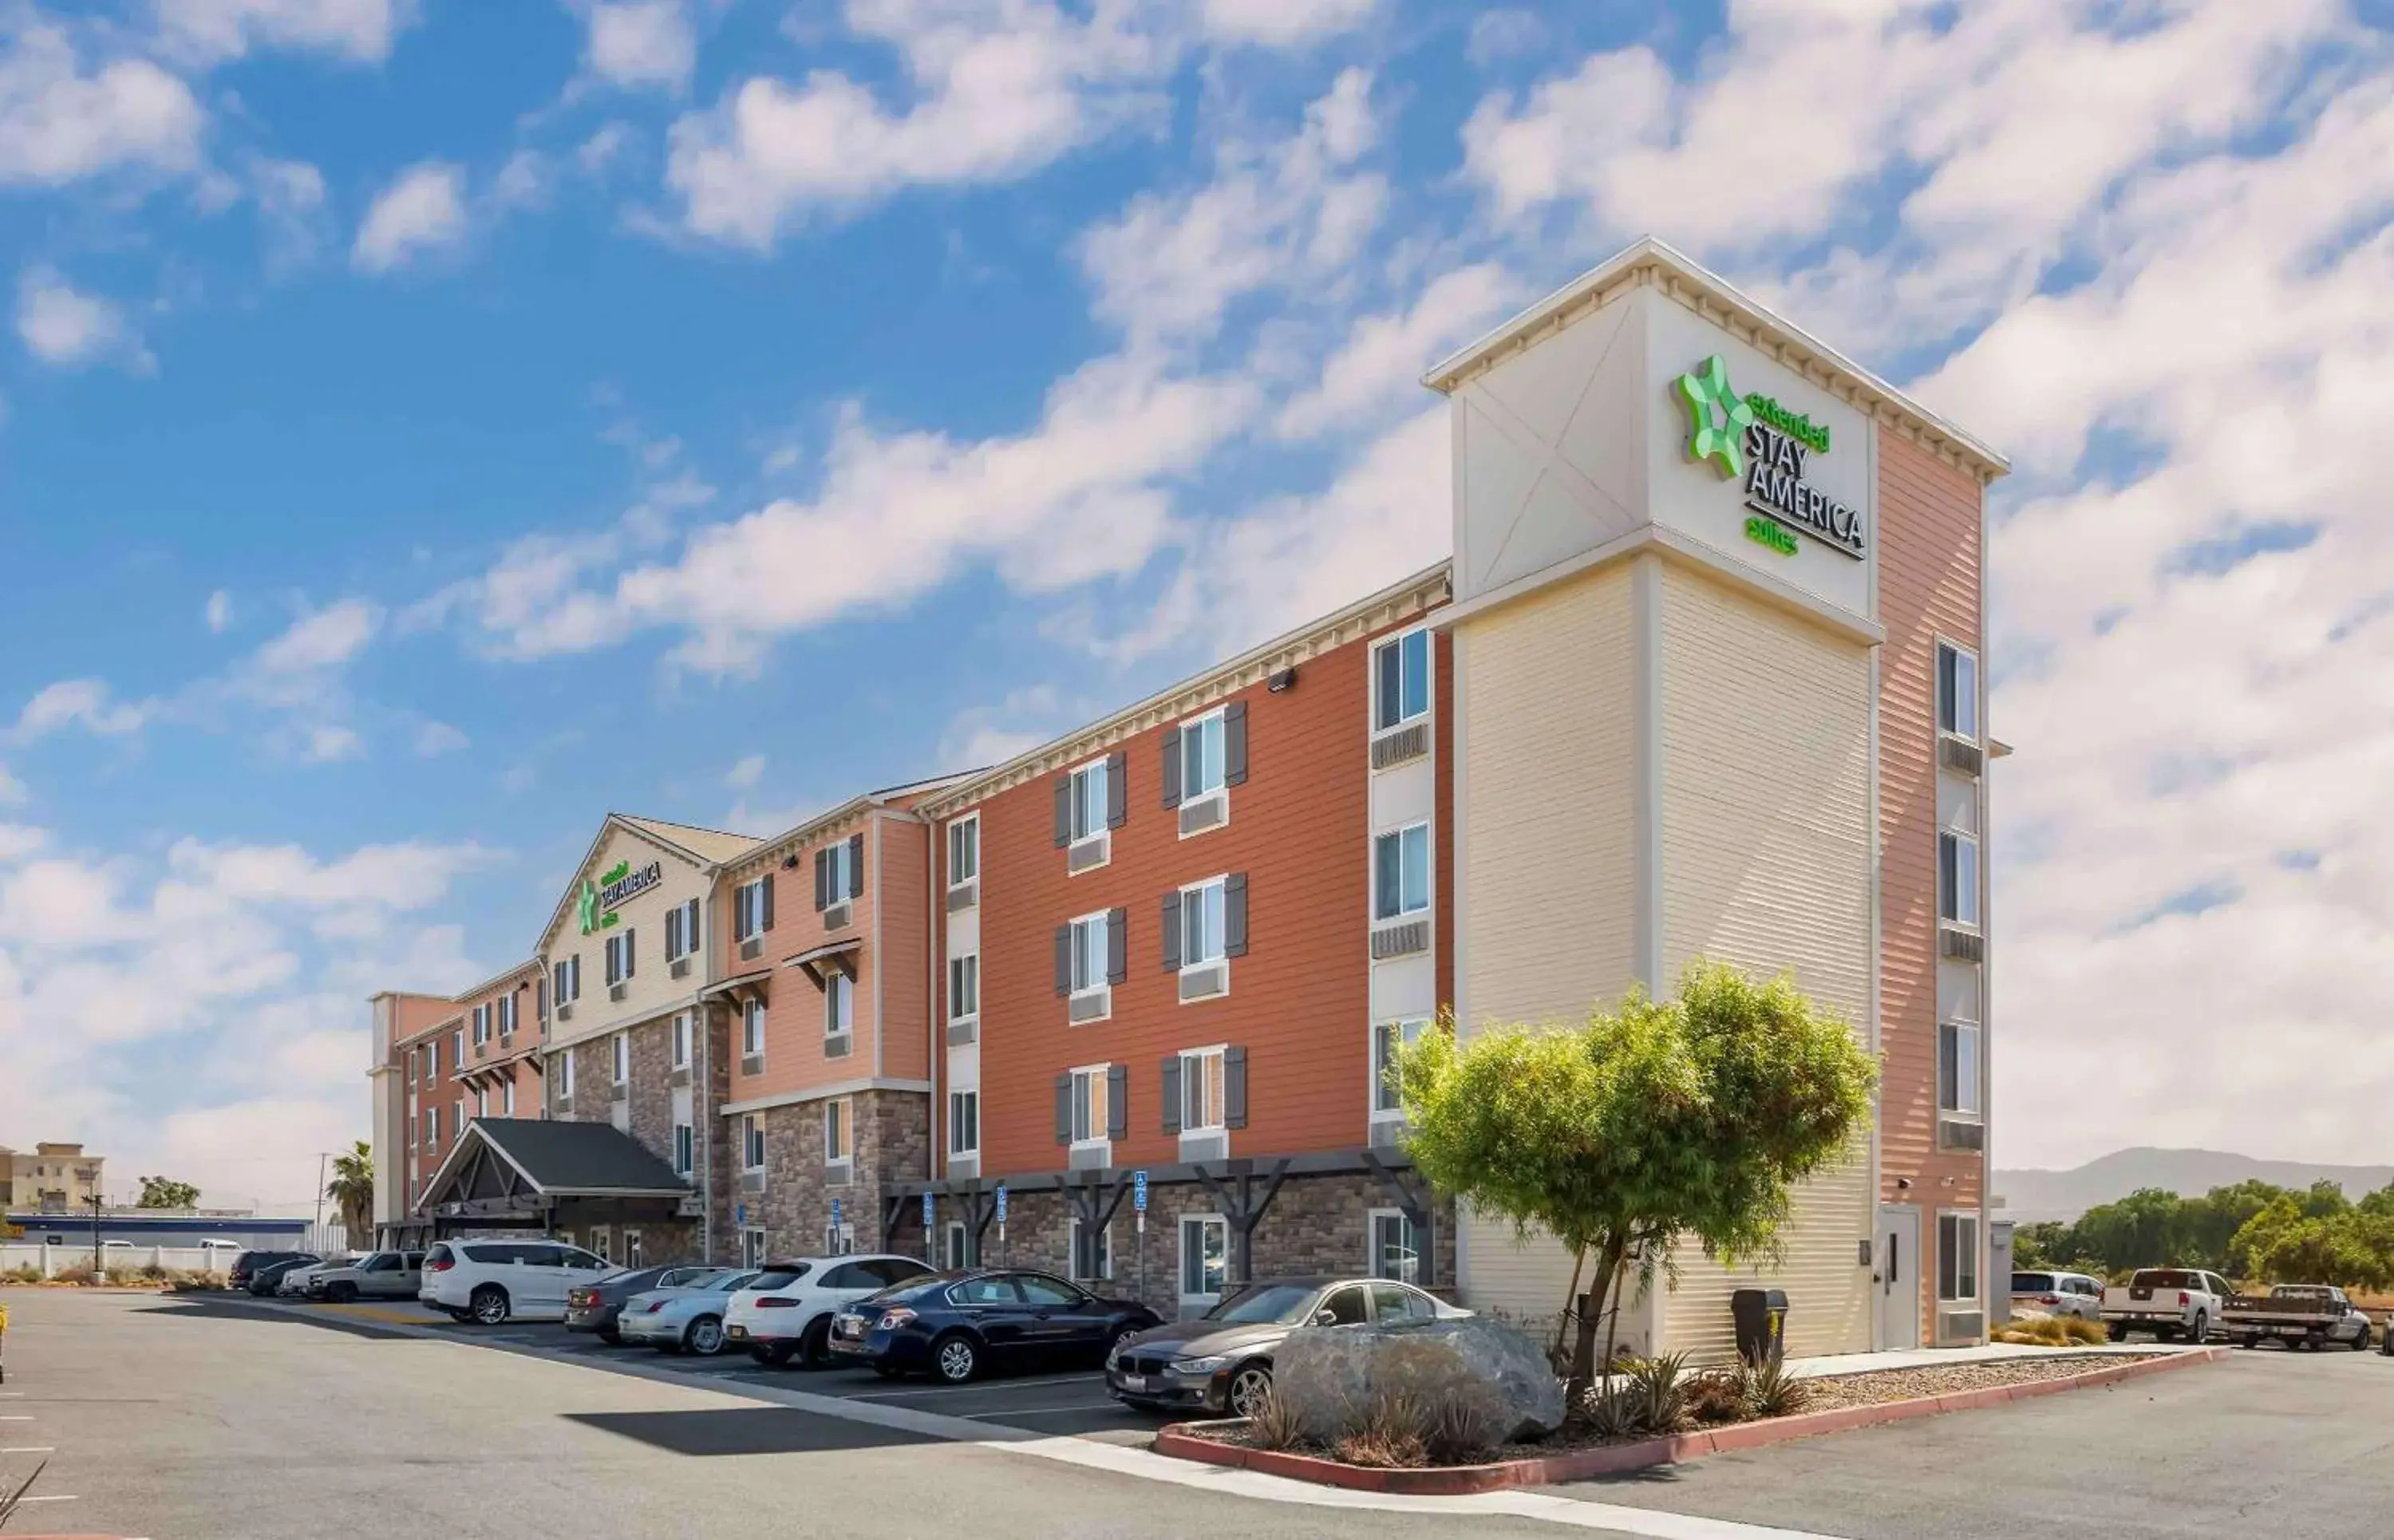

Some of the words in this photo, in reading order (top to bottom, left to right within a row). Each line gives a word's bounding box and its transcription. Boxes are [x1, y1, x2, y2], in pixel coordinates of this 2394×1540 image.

[1745, 392, 1829, 453] extended
[1746, 421, 1810, 478] STAY
[1745, 461, 1863, 548] AMERICA
[1746, 516, 1799, 556] suites
